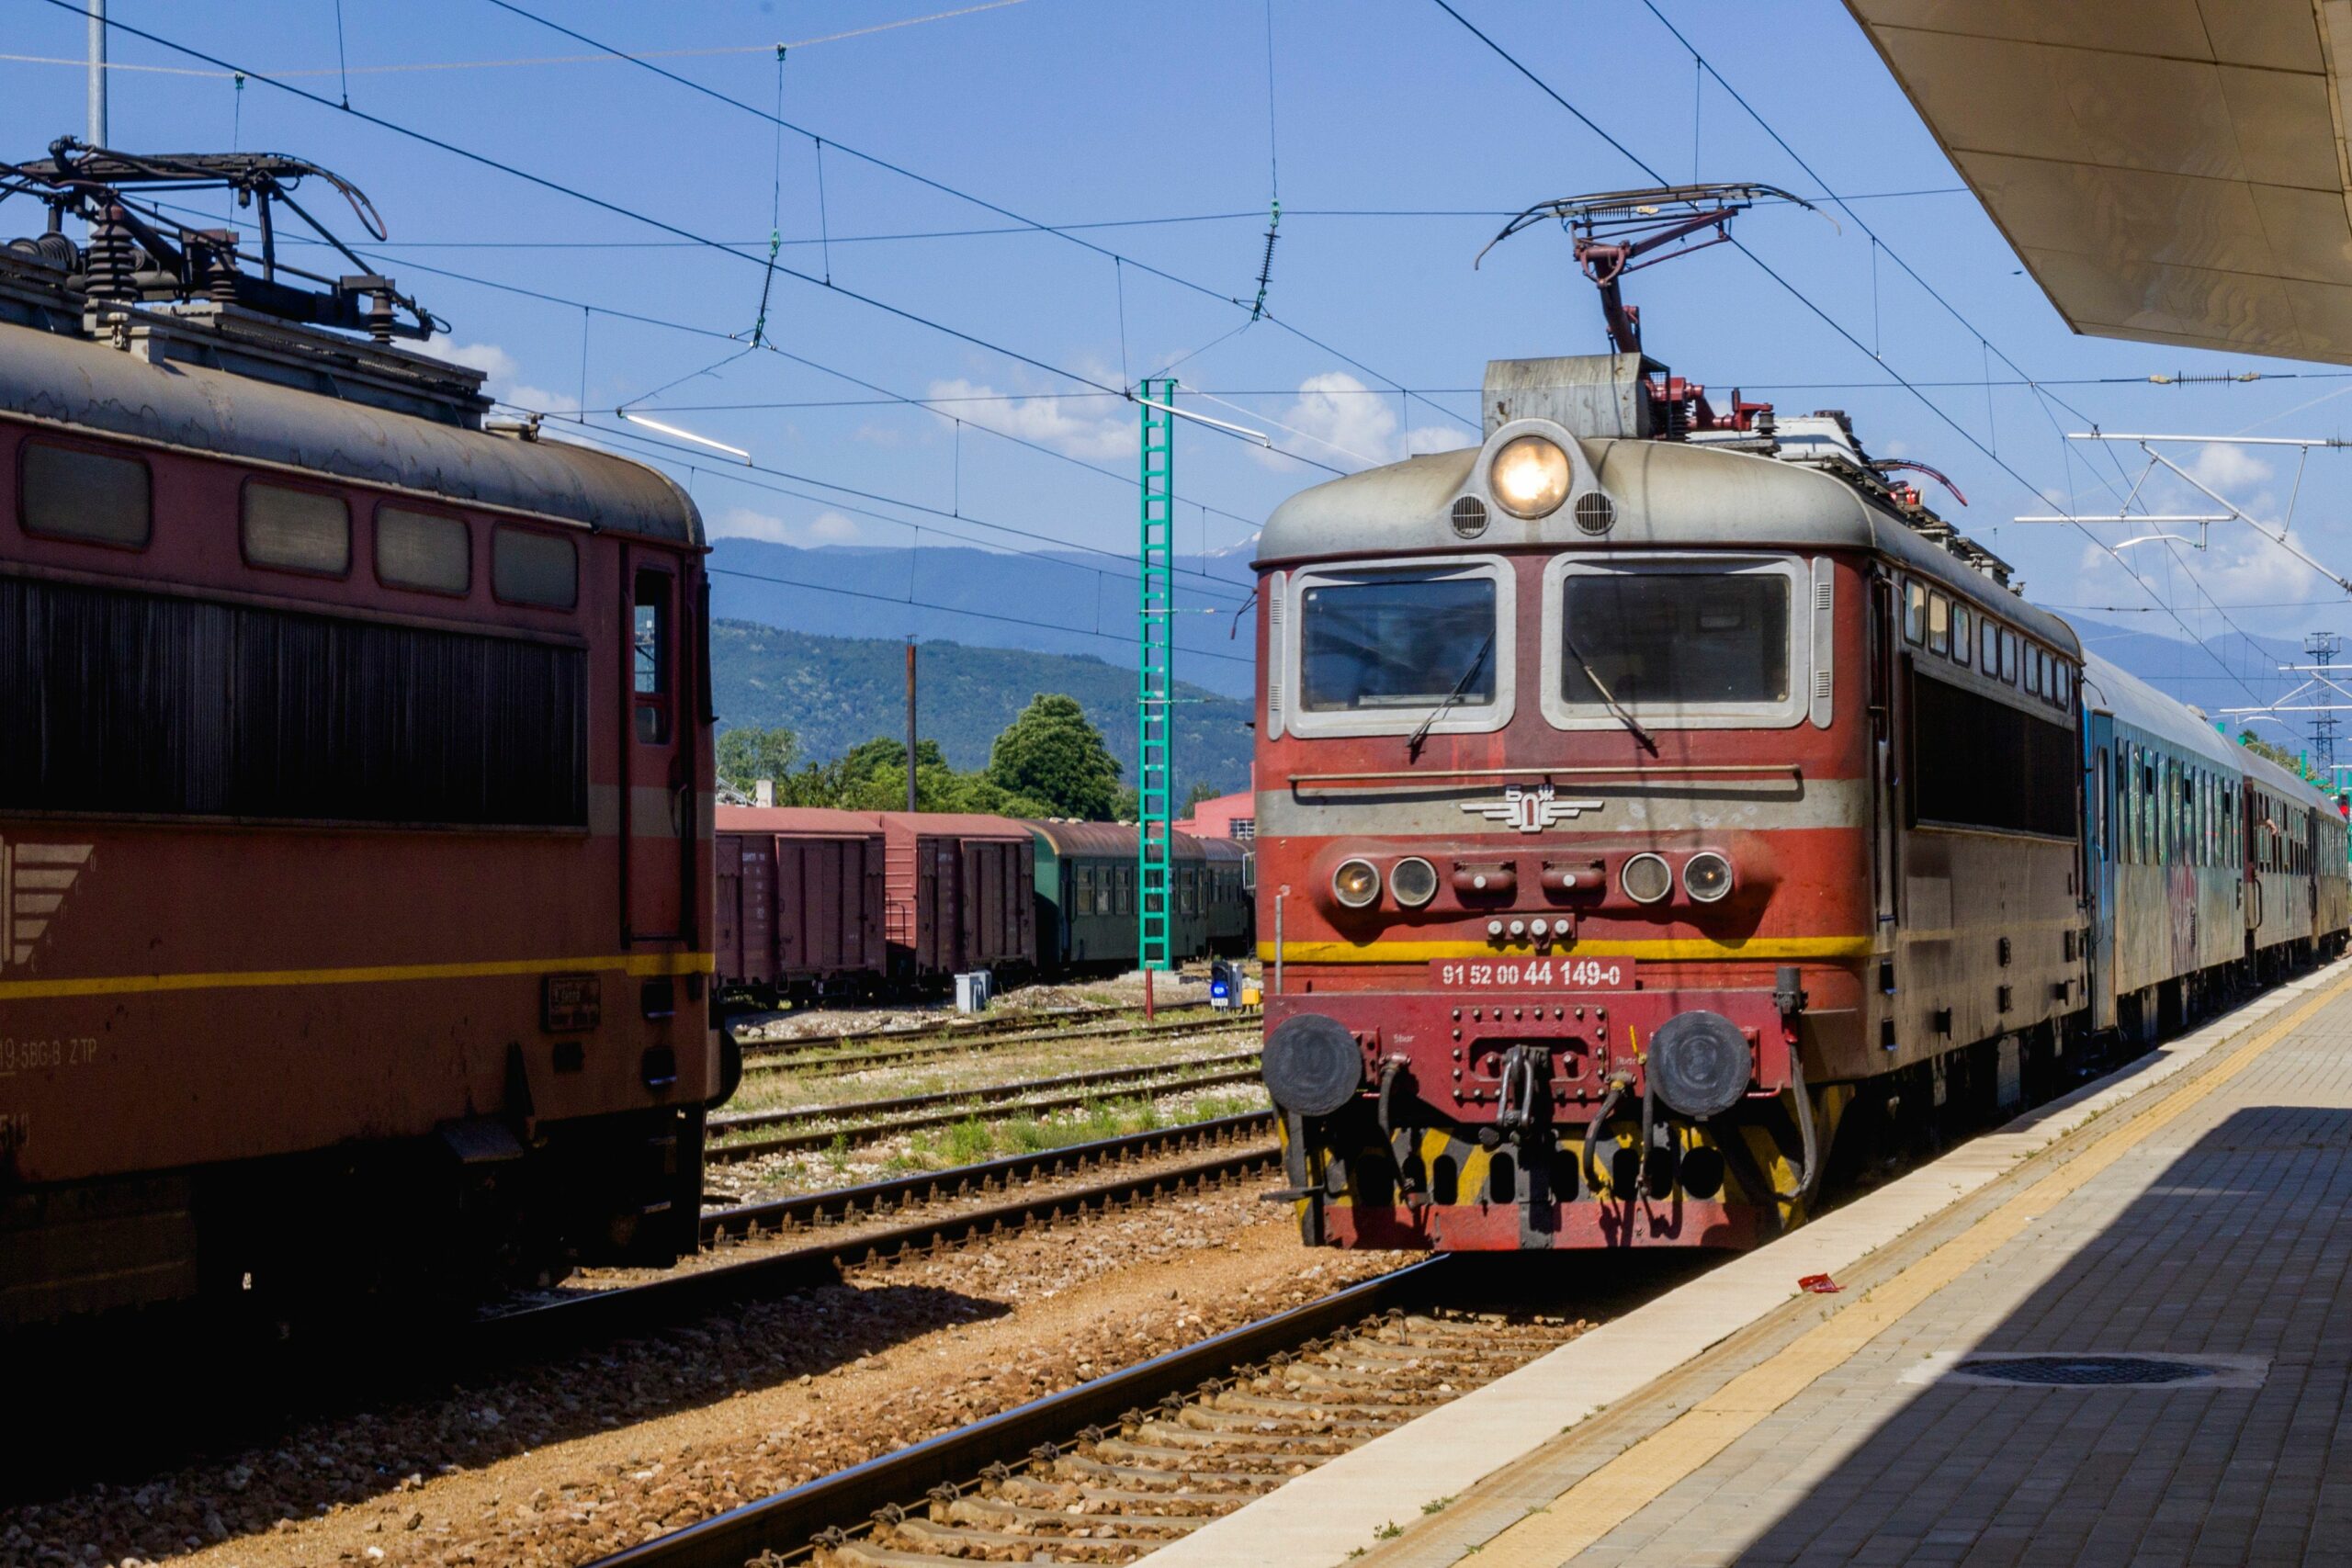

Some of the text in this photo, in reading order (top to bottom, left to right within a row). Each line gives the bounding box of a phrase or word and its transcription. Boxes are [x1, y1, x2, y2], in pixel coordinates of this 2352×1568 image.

[1442, 961, 1621, 986] 91 52 00 44 149-0
